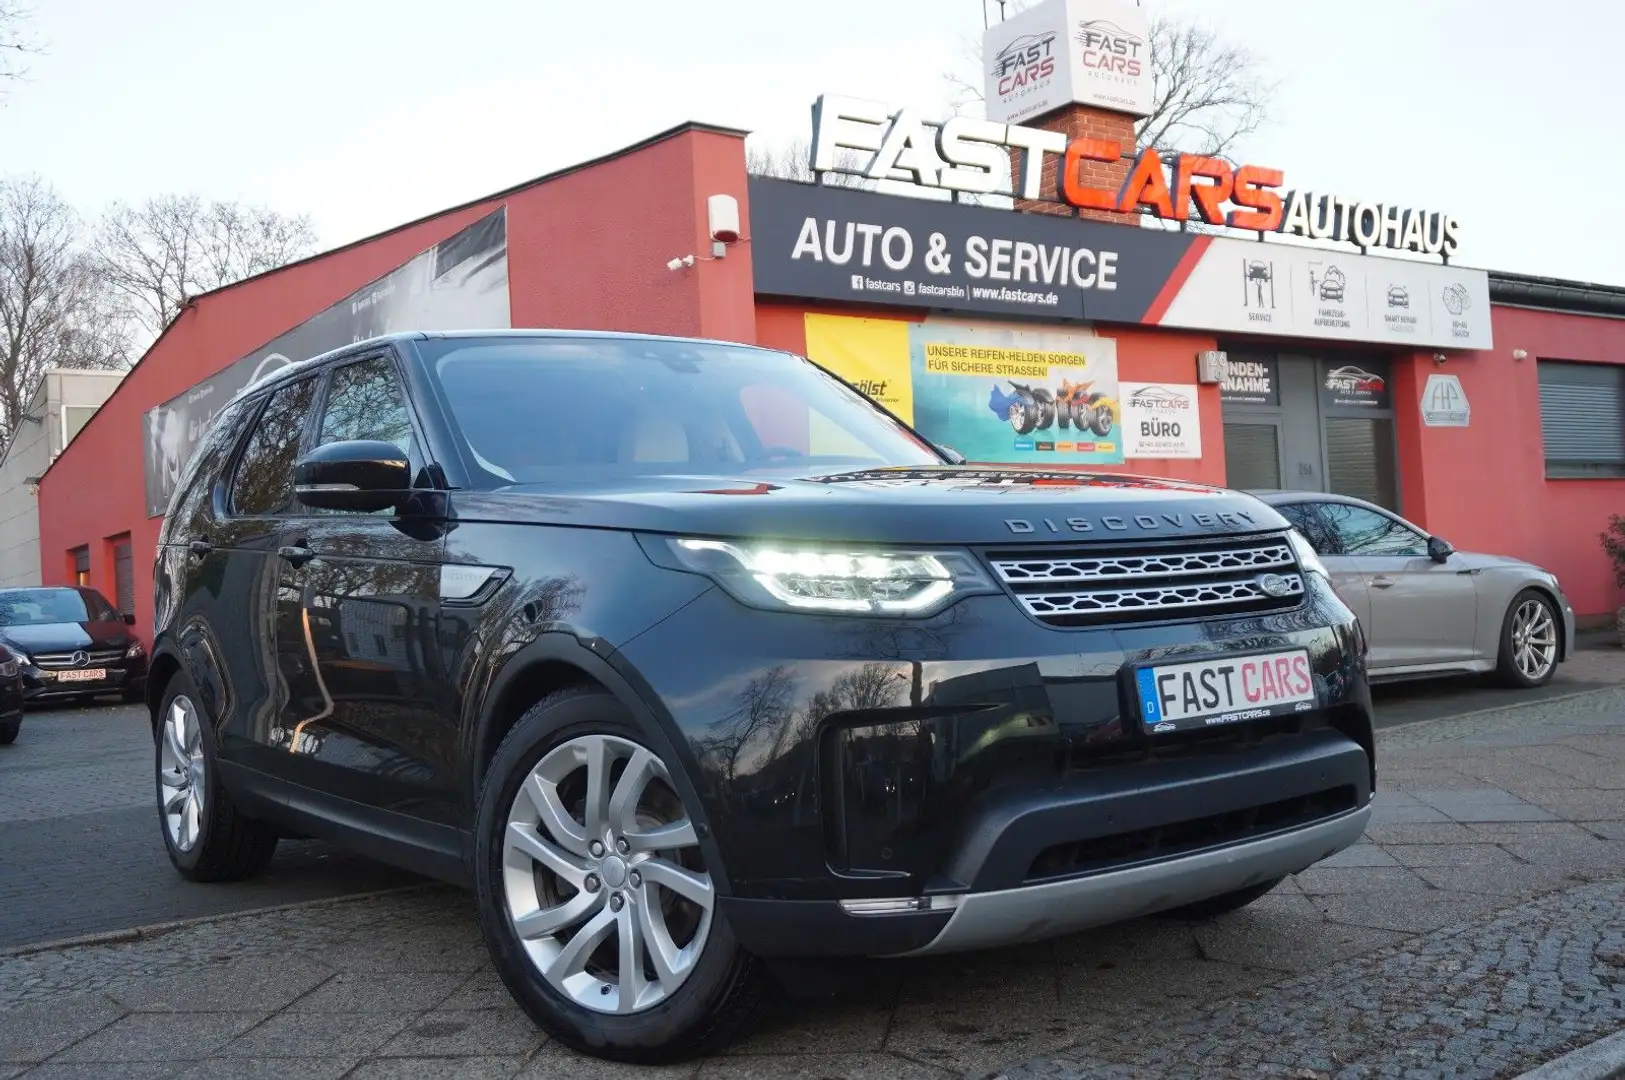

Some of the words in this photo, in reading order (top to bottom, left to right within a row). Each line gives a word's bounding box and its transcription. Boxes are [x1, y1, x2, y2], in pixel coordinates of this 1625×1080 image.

[1085, 30, 1142, 57] FAST
[999, 36, 1056, 78] FAST
[1083, 51, 1141, 77] CARS
[998, 57, 1055, 96] CARS
[1283, 190, 1462, 256] AUTOHAUS
[791, 216, 914, 270] AUTO
[924, 231, 952, 275] &
[963, 235, 1119, 290] SERVICE
[865, 278, 901, 292] fastcars
[972, 286, 1059, 305] www.fastcars.de
[1248, 312, 1272, 323] SERVICE
[927, 345, 968, 358] UNSERE
[970, 349, 1046, 363] REIFEN-HELDEN
[1048, 354, 1086, 366] SORGEN
[928, 358, 949, 371] FÜR
[951, 361, 994, 374] SICHERE
[996, 365, 1048, 377] STRASSEN!
[1228, 361, 1268, 378] NDEN-
[1220, 377, 1271, 392] NNAHME
[1140, 416, 1181, 437] BÜRO
[1004, 510, 1258, 534] DISCOVERY
[60, 671, 81, 679] FAST
[83, 669, 104, 678] CARS
[1157, 665, 1234, 717] FAST
[1241, 655, 1311, 704] CARS
[1146, 701, 1154, 714] D
